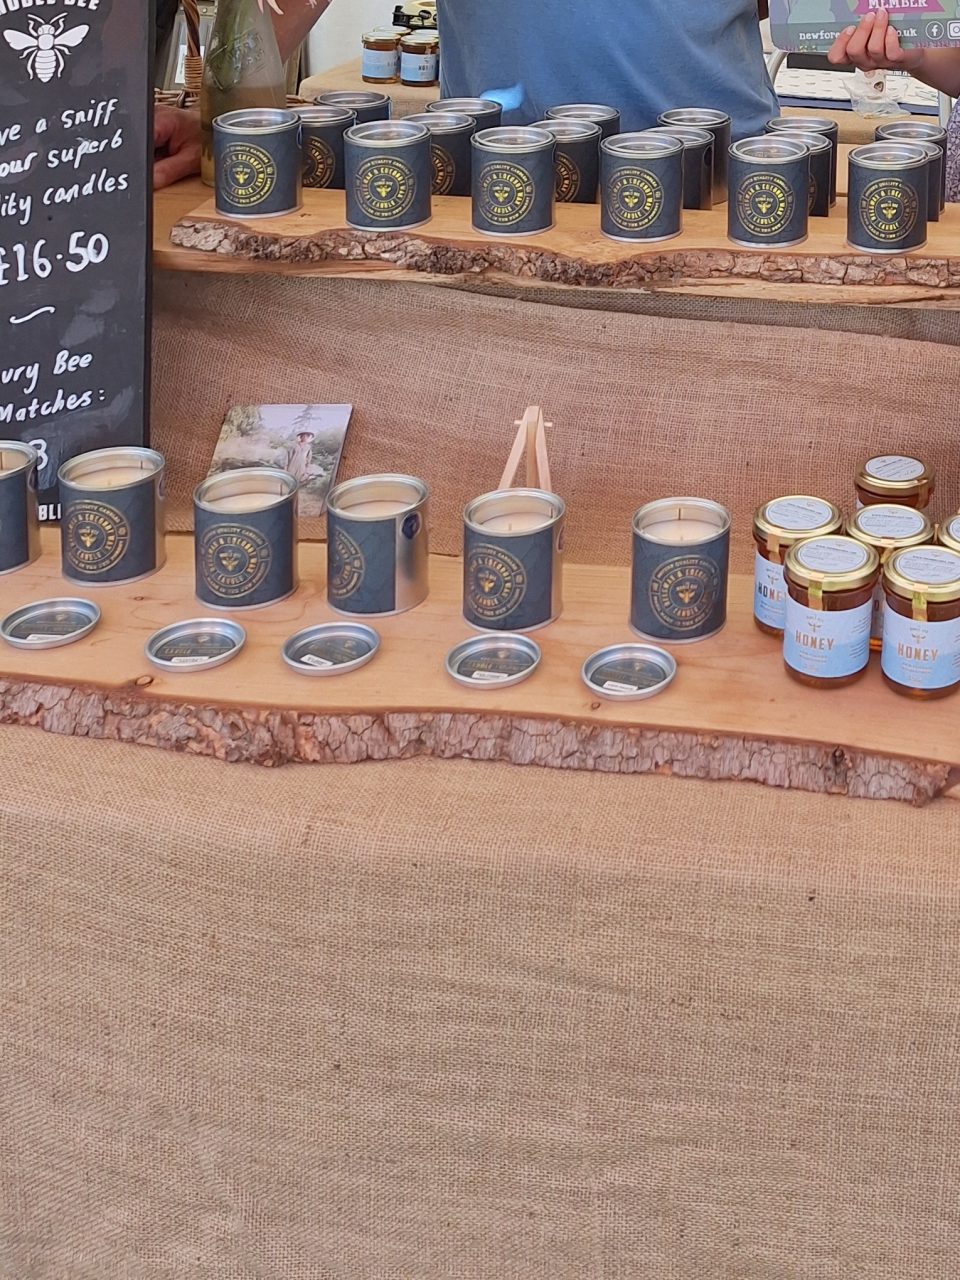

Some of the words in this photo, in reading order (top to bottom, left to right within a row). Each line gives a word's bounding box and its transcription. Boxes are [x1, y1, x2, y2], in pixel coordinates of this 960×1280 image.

[35, 118, 48, 133] a
[47, 128, 123, 169] superb
[43, 168, 129, 205] candles
[1, 363, 40, 395] ury
[53, 349, 93, 375] Bee
[758, 582, 786, 603] HONE
[795, 630, 835, 651] HONEY
[897, 643, 939, 663] HONEY
